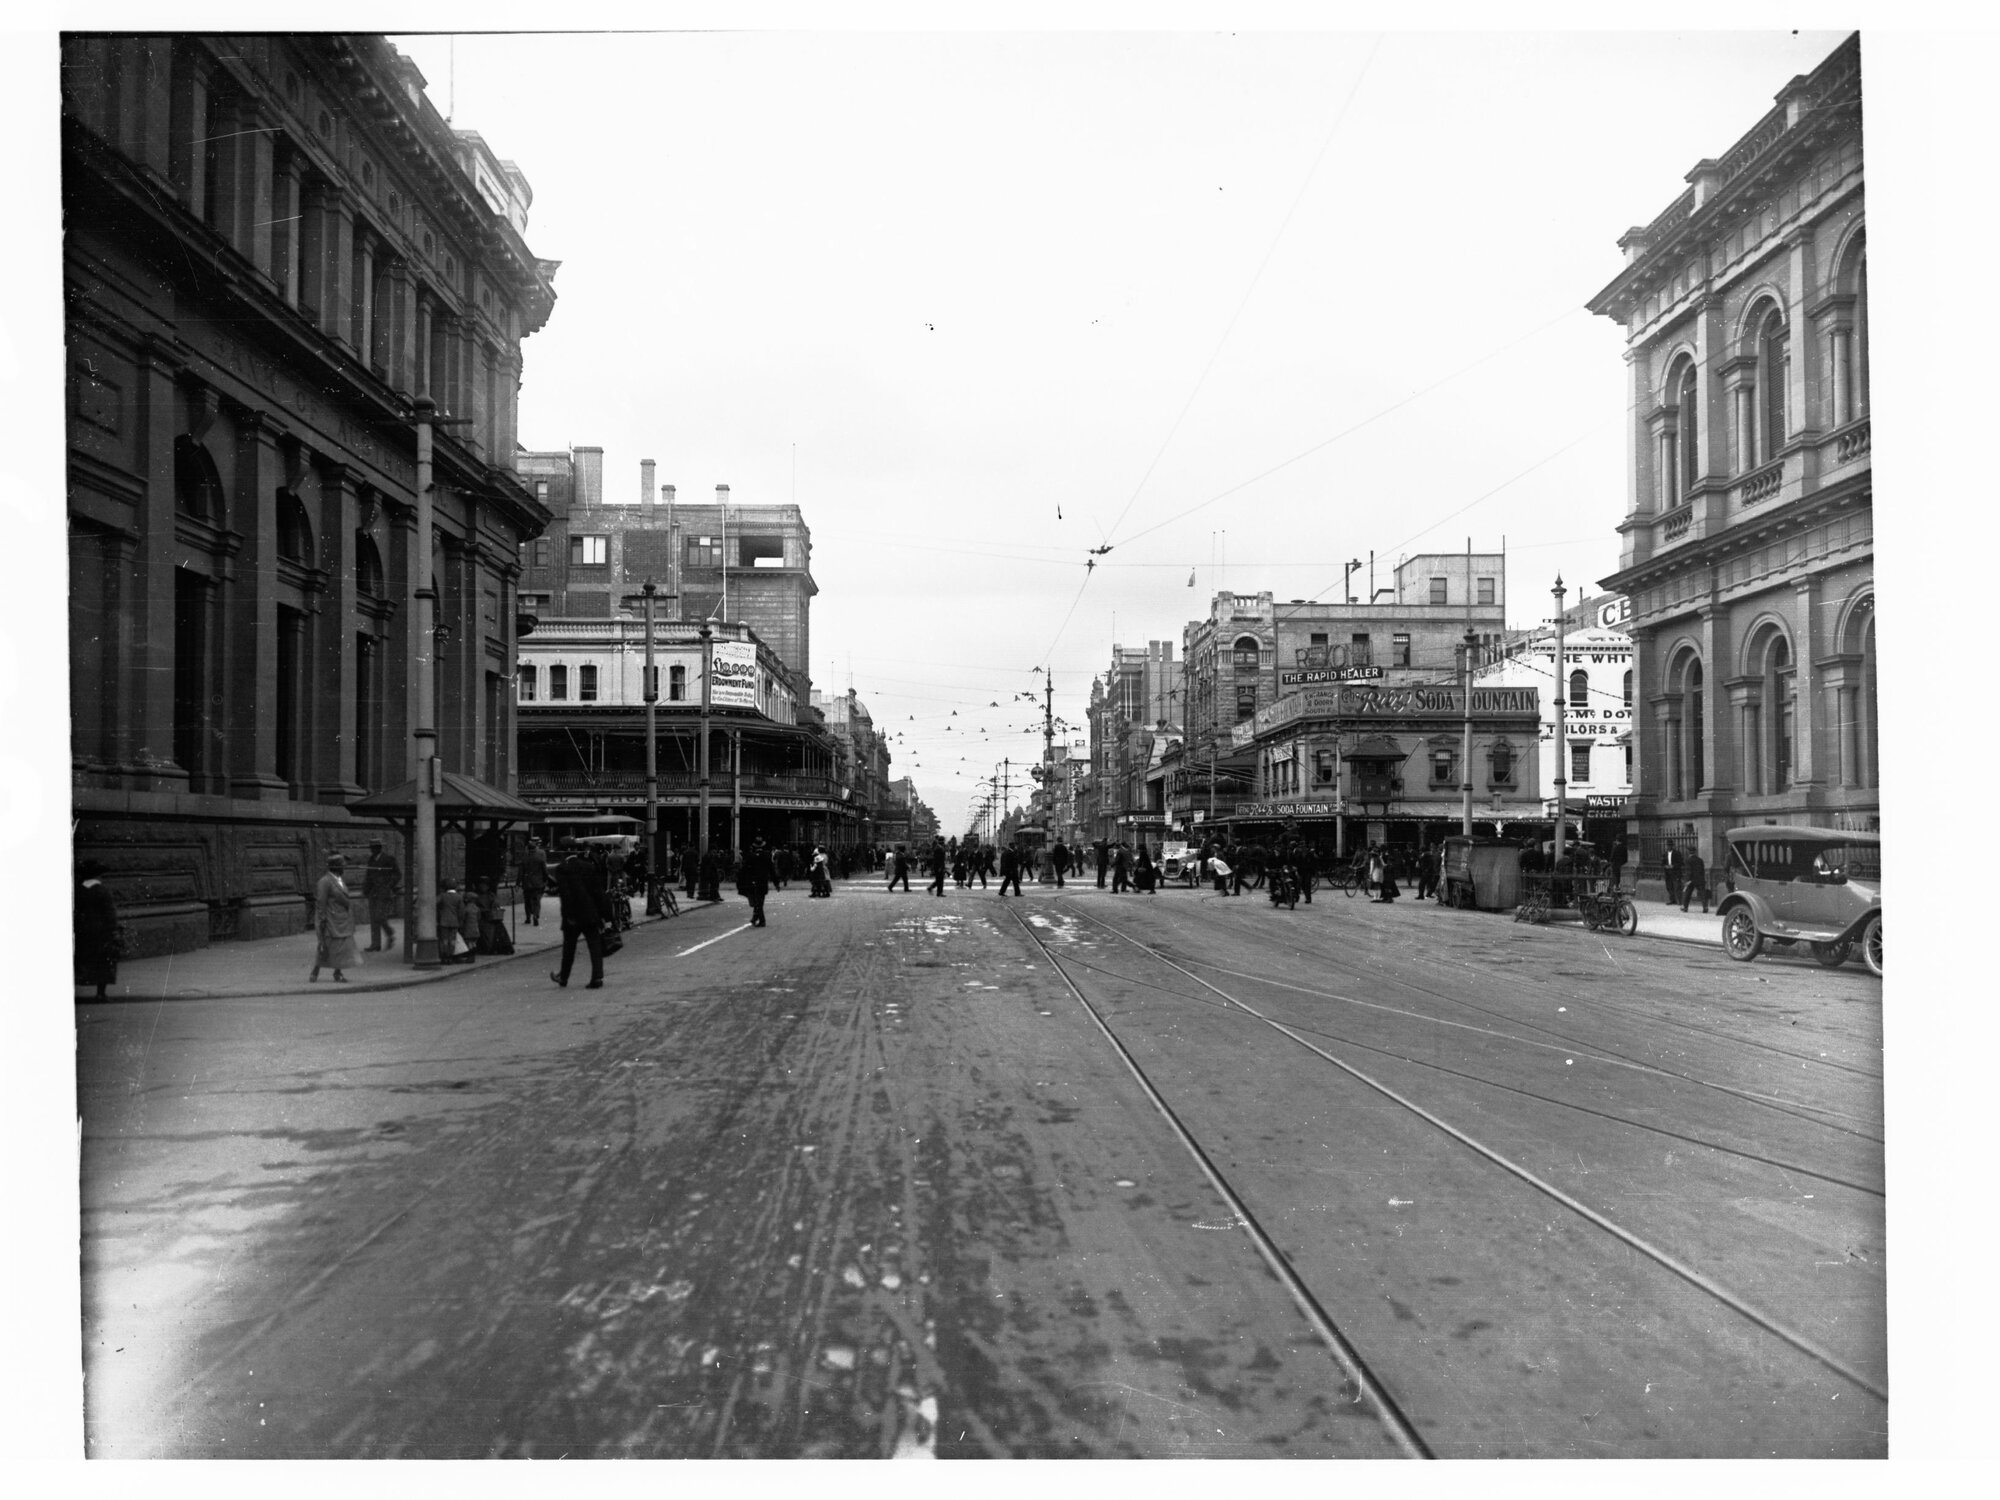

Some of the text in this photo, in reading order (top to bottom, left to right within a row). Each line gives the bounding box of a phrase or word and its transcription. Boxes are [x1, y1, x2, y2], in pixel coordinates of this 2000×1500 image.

[1547, 653, 1583, 664] THE
[1284, 667, 1379, 683] THE RAPID HEALER
[1416, 689, 1455, 711] SODA
[1463, 690, 1535, 711] OUNTAIN
[1546, 724, 1618, 734] TILORS &
[1276, 804, 1294, 815] SODA
[1295, 803, 1329, 815] FOUNTAIN
